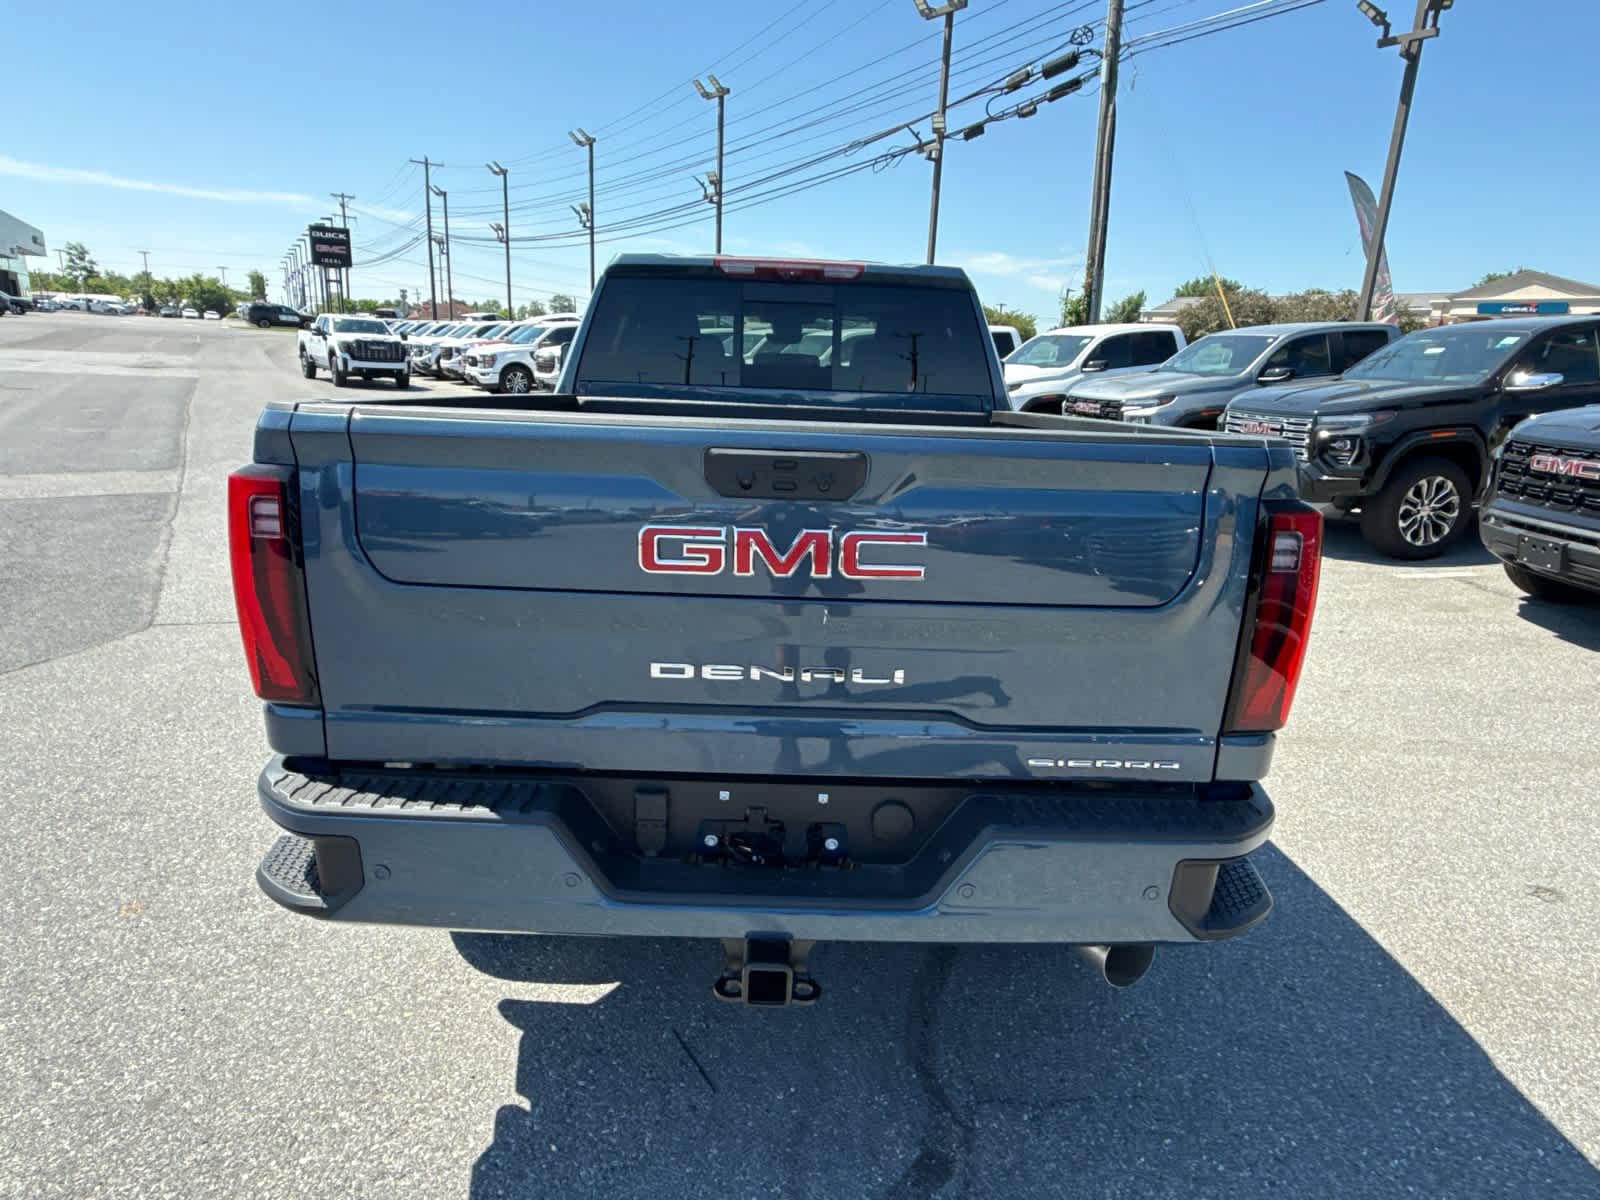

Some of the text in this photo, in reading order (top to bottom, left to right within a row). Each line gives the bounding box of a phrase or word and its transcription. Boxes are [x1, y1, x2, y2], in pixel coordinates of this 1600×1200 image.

[311, 231, 348, 241] BUICK
[1530, 455, 1600, 480] GMC
[638, 525, 928, 580] GMC
[650, 662, 905, 685] DENALI
[1028, 759, 1180, 769] SIERRA
